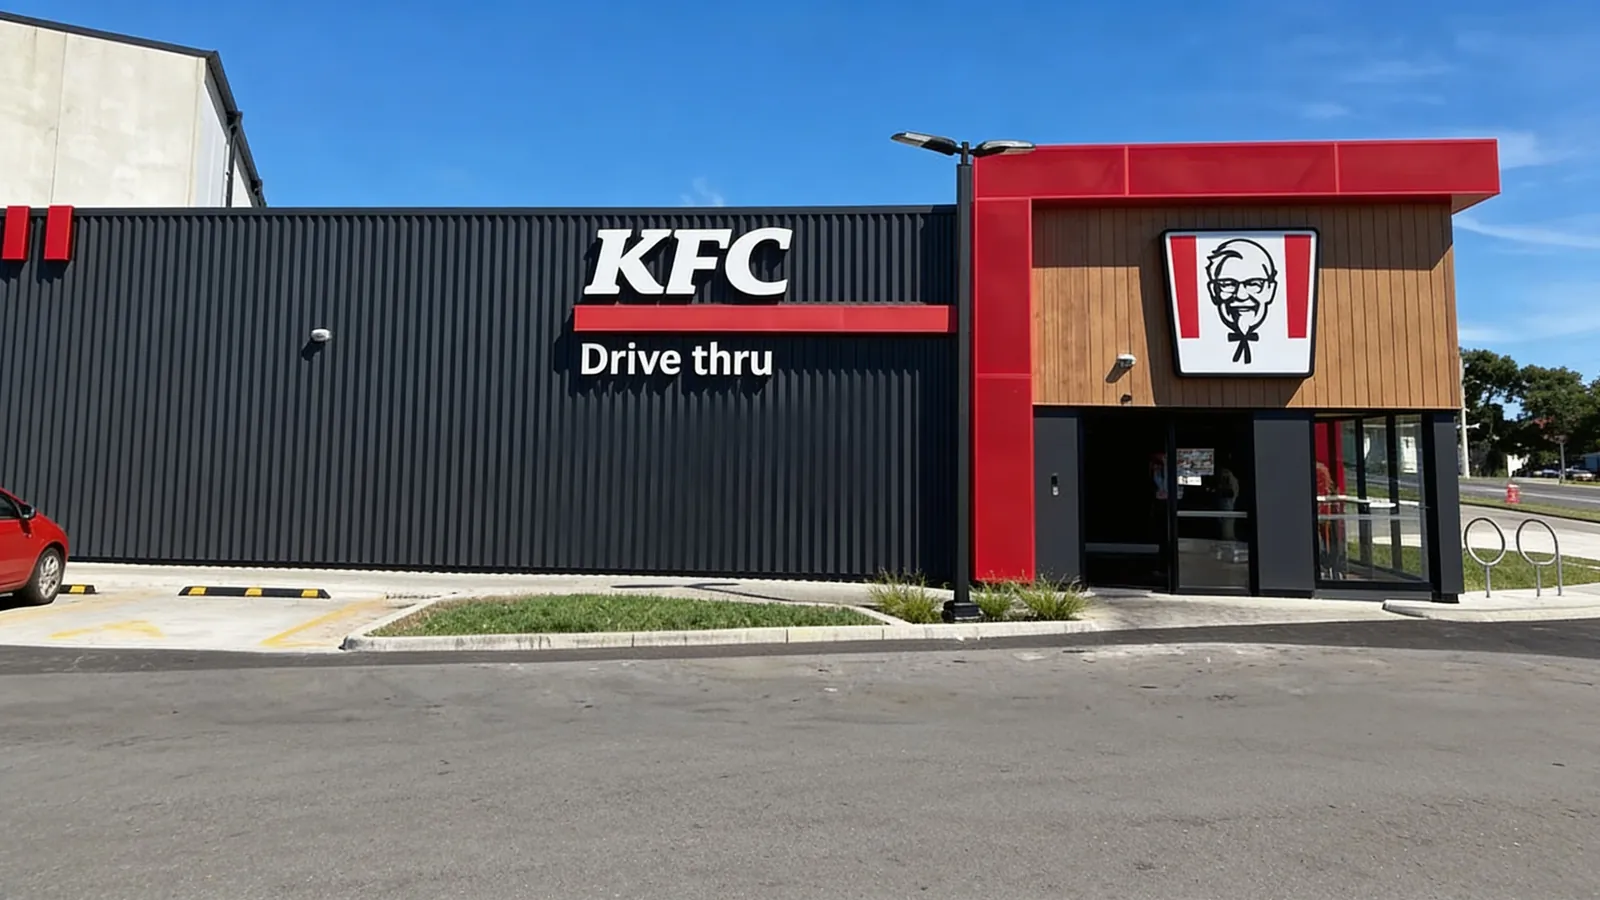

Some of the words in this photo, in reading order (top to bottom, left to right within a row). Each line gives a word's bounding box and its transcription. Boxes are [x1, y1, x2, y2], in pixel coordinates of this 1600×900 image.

[584, 227, 792, 296] KFC
[581, 342, 682, 375] Drive
[692, 341, 773, 376] thru
